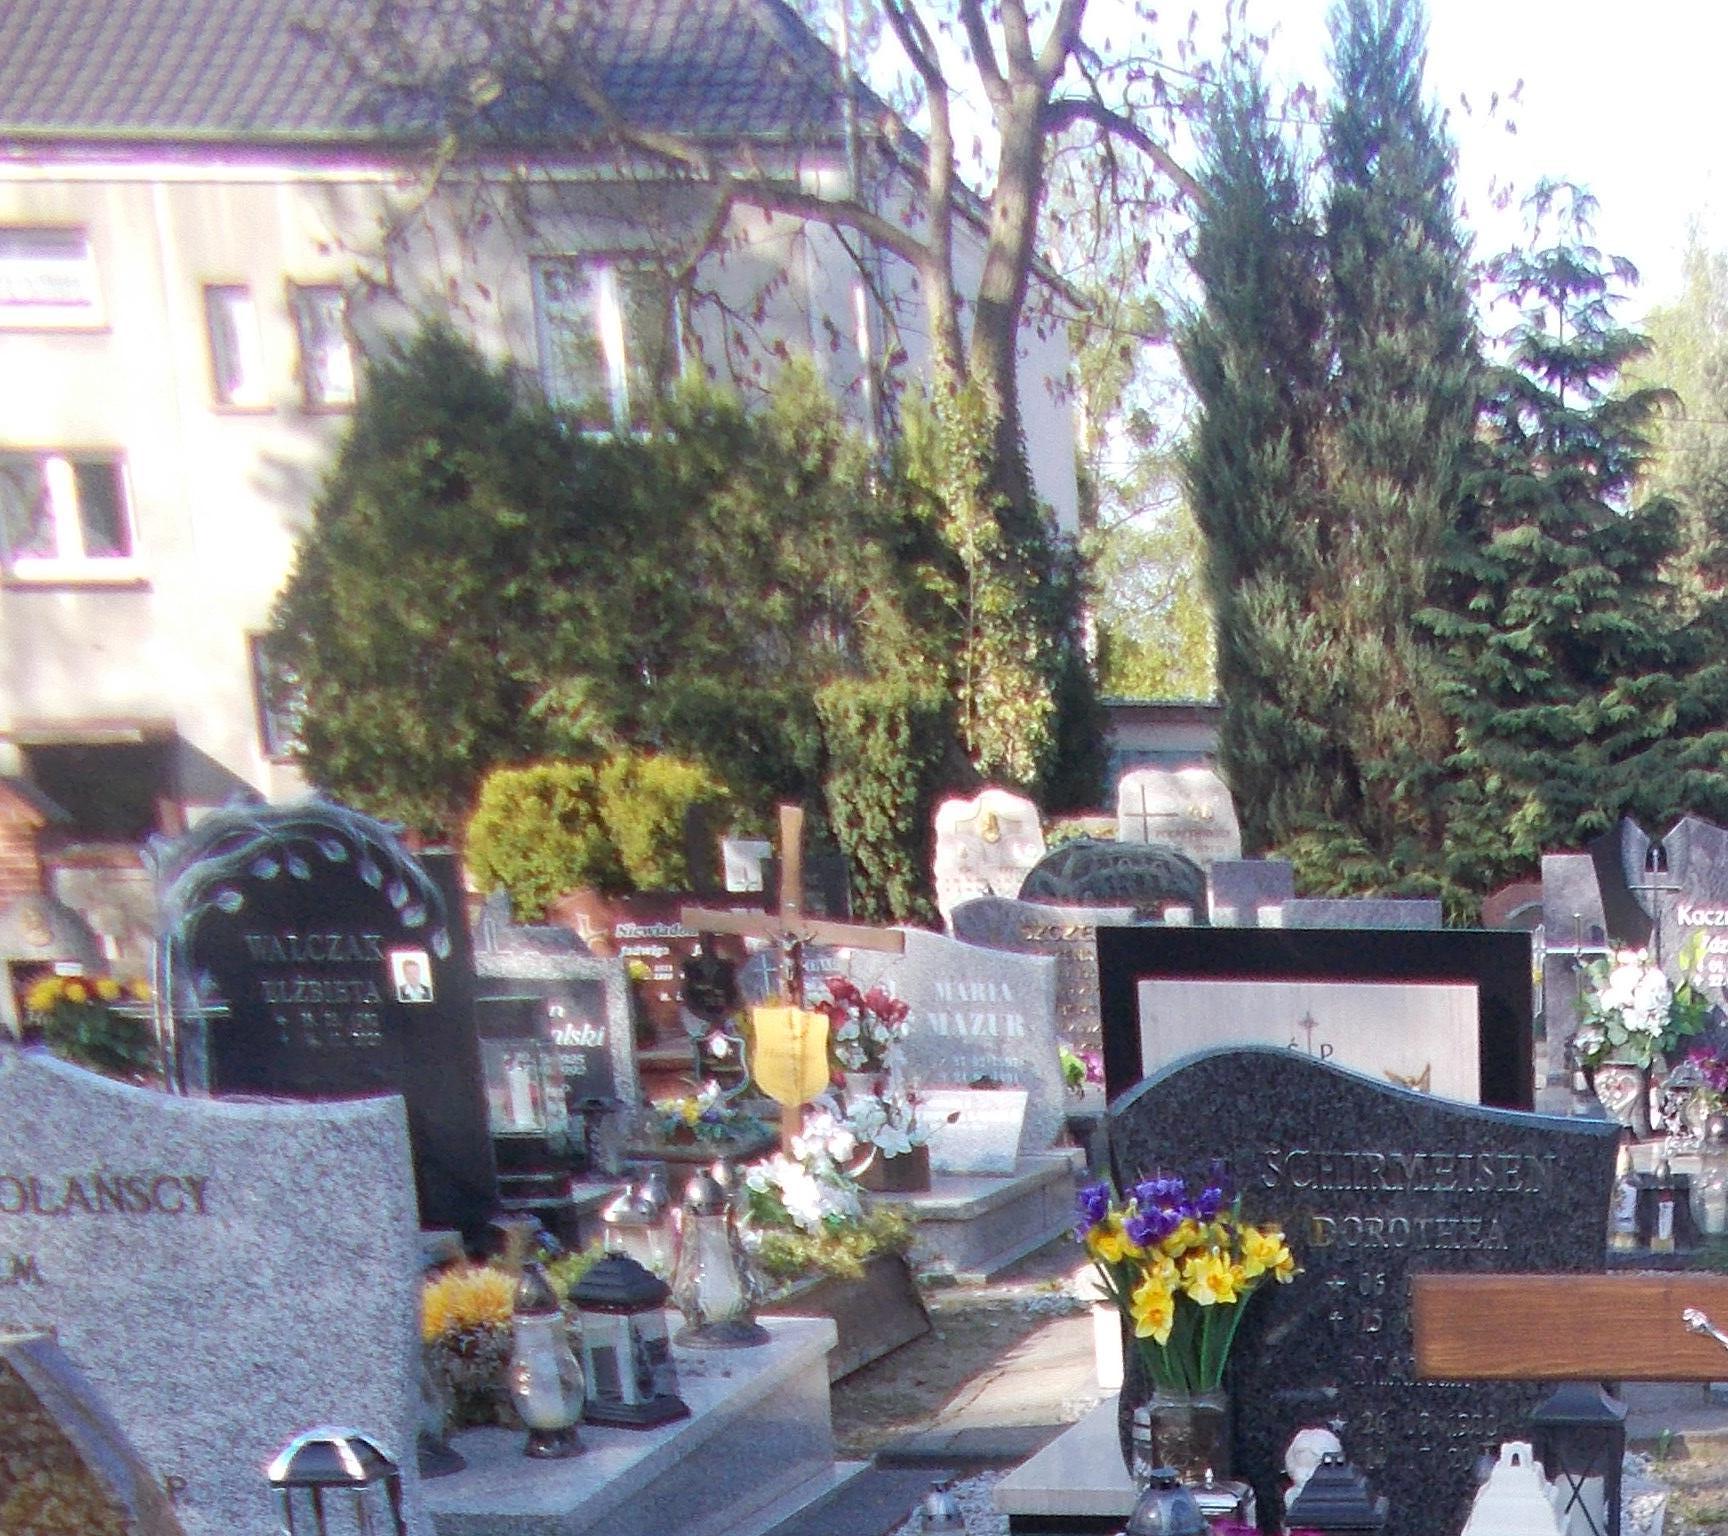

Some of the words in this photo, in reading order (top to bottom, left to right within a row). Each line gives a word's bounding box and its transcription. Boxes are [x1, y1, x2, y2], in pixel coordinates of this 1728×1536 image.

[934, 982, 1013, 1002] MARIA
[926, 1012, 1026, 1038] MAZUR
[1261, 1149, 1557, 1193] SCHIRMEISEN
[0, 1162, 209, 1217] OLAŃSCY
[1308, 1216, 1510, 1250] DOROTHEA
